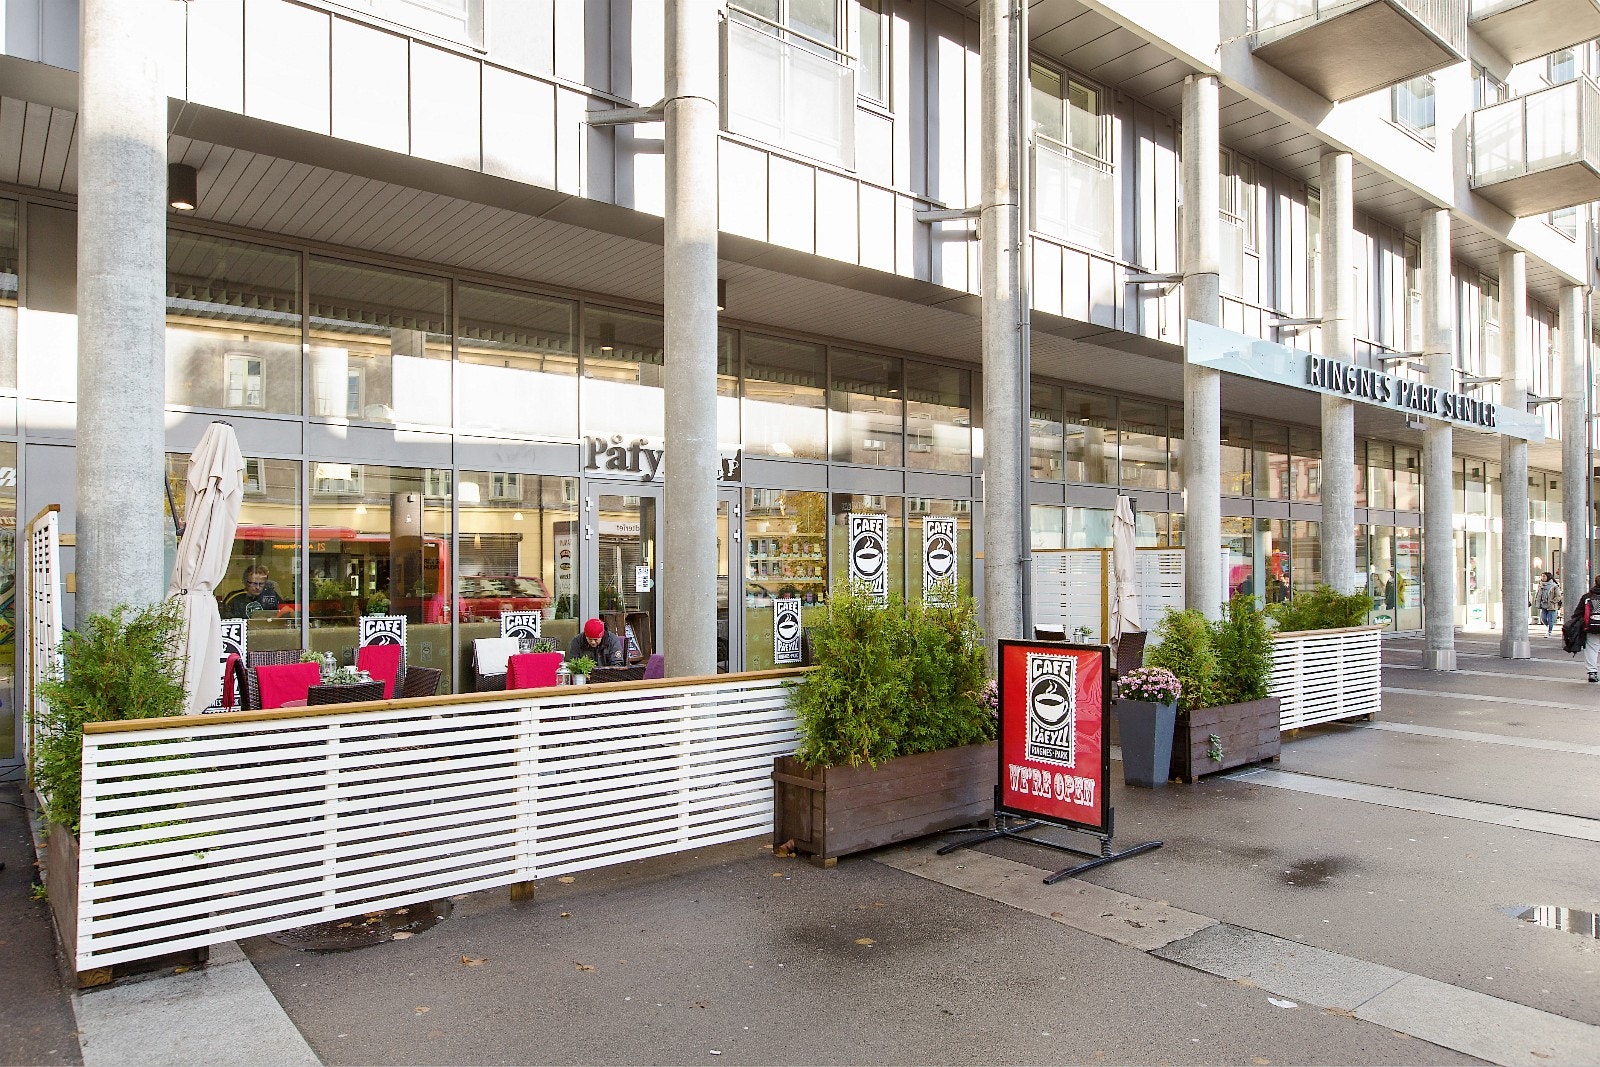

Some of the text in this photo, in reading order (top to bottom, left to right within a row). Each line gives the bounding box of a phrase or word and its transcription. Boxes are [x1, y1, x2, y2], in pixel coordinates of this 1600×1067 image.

[1306, 354, 1497, 428] RINGNES PARK SENTER
[583, 434, 665, 482] Påfy
[853, 518, 884, 537] CAFE
[927, 521, 953, 539] CAFE
[778, 602, 798, 615] CAFE
[365, 620, 401, 637] CAFE
[506, 615, 536, 631] CAFE
[221, 625, 241, 642] FE
[1033, 659, 1071, 683] CAFE
[1008, 764, 1096, 808] WE'RE OPEN
